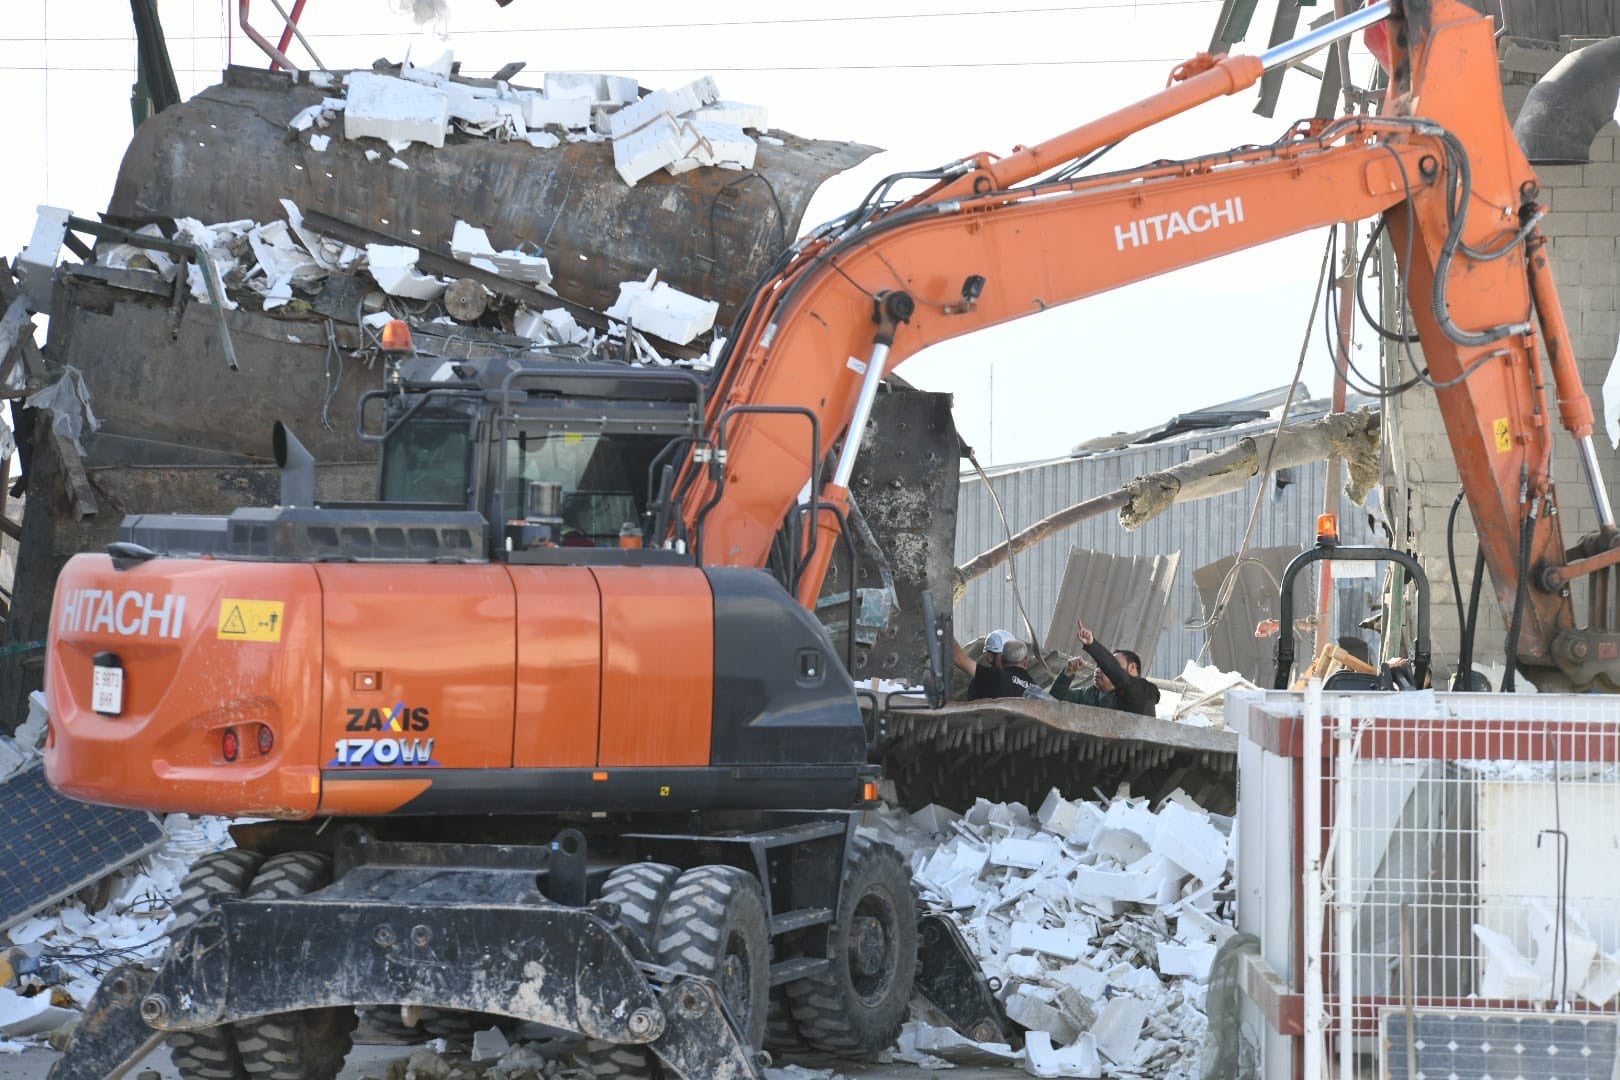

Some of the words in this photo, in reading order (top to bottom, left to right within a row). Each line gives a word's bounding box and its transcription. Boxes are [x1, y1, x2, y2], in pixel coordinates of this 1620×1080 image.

[1113, 196, 1245, 251] HITACHI
[59, 588, 187, 639] HITACHI
[345, 701, 430, 733] ZAXIS
[335, 738, 435, 766] 170W
